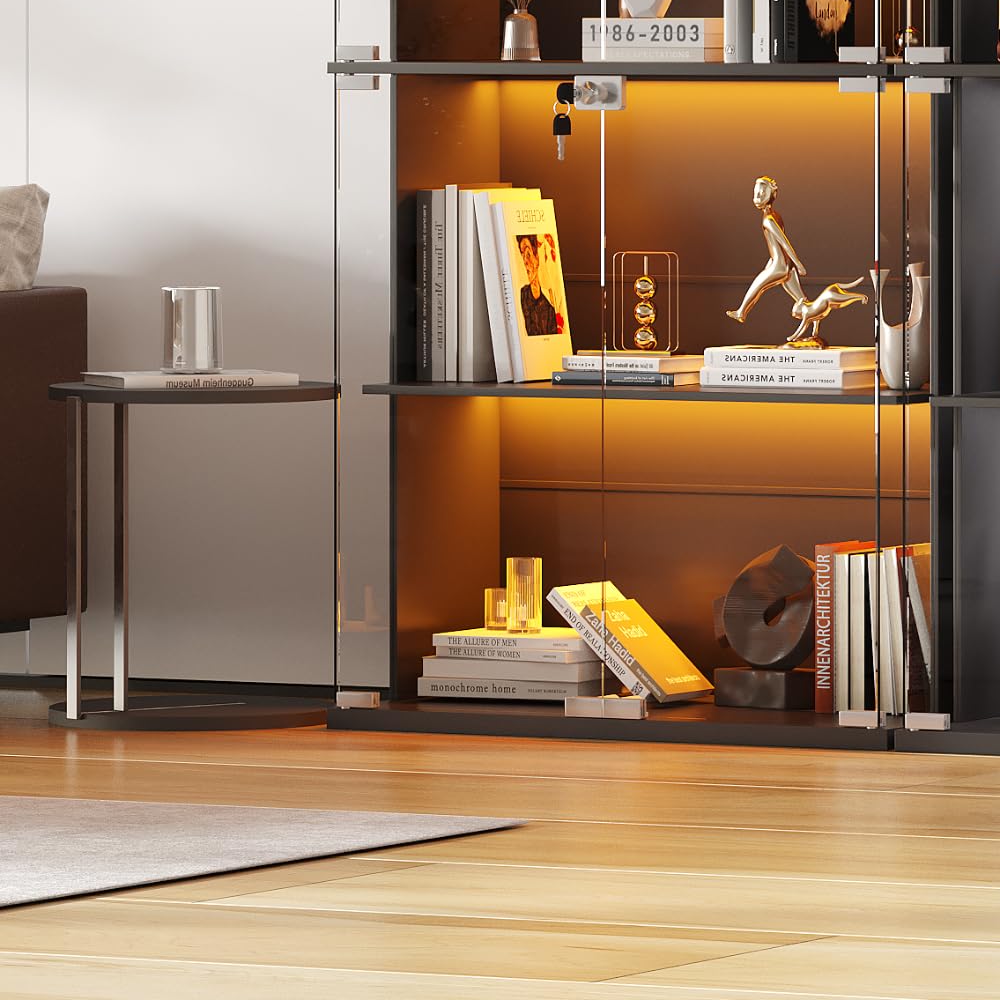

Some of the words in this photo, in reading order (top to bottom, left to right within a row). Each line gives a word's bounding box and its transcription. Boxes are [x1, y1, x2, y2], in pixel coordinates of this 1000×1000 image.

[563, 607, 577, 624] END
[575, 619, 586, 632] OF
[816, 554, 831, 689] INNENARCHITEKTUR
[448, 637, 462, 645] THE
[464, 638, 490, 646] ALLURE
[501, 639, 517, 647] MEN
[607, 634, 635, 666] Hadid
[448, 647, 462, 656] THE
[462, 648, 486, 657] ALLURE
[497, 650, 521, 658] WOMEN
[430, 682, 488, 693] monochrome
[492, 683, 516, 693] home
